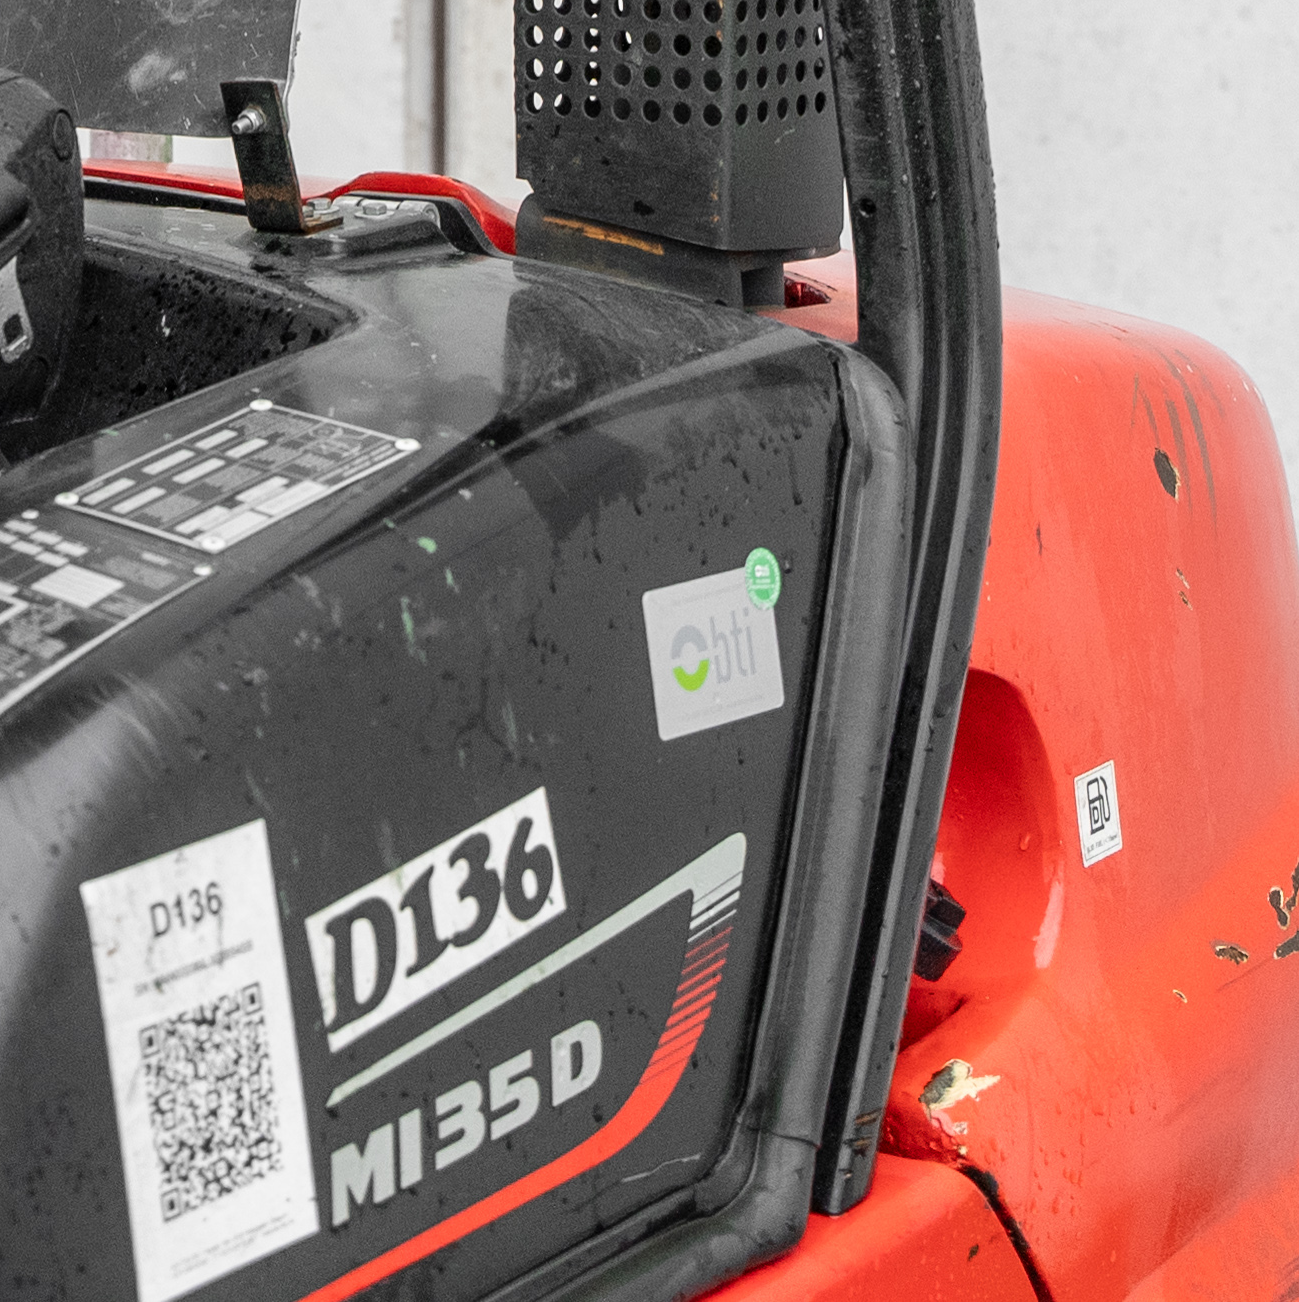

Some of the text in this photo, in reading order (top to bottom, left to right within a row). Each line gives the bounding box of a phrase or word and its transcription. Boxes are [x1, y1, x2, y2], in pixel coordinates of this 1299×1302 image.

[150, 881, 223, 938] D136
[325, 817, 553, 1035] D136
[330, 1019, 602, 1227] MI 35 D
